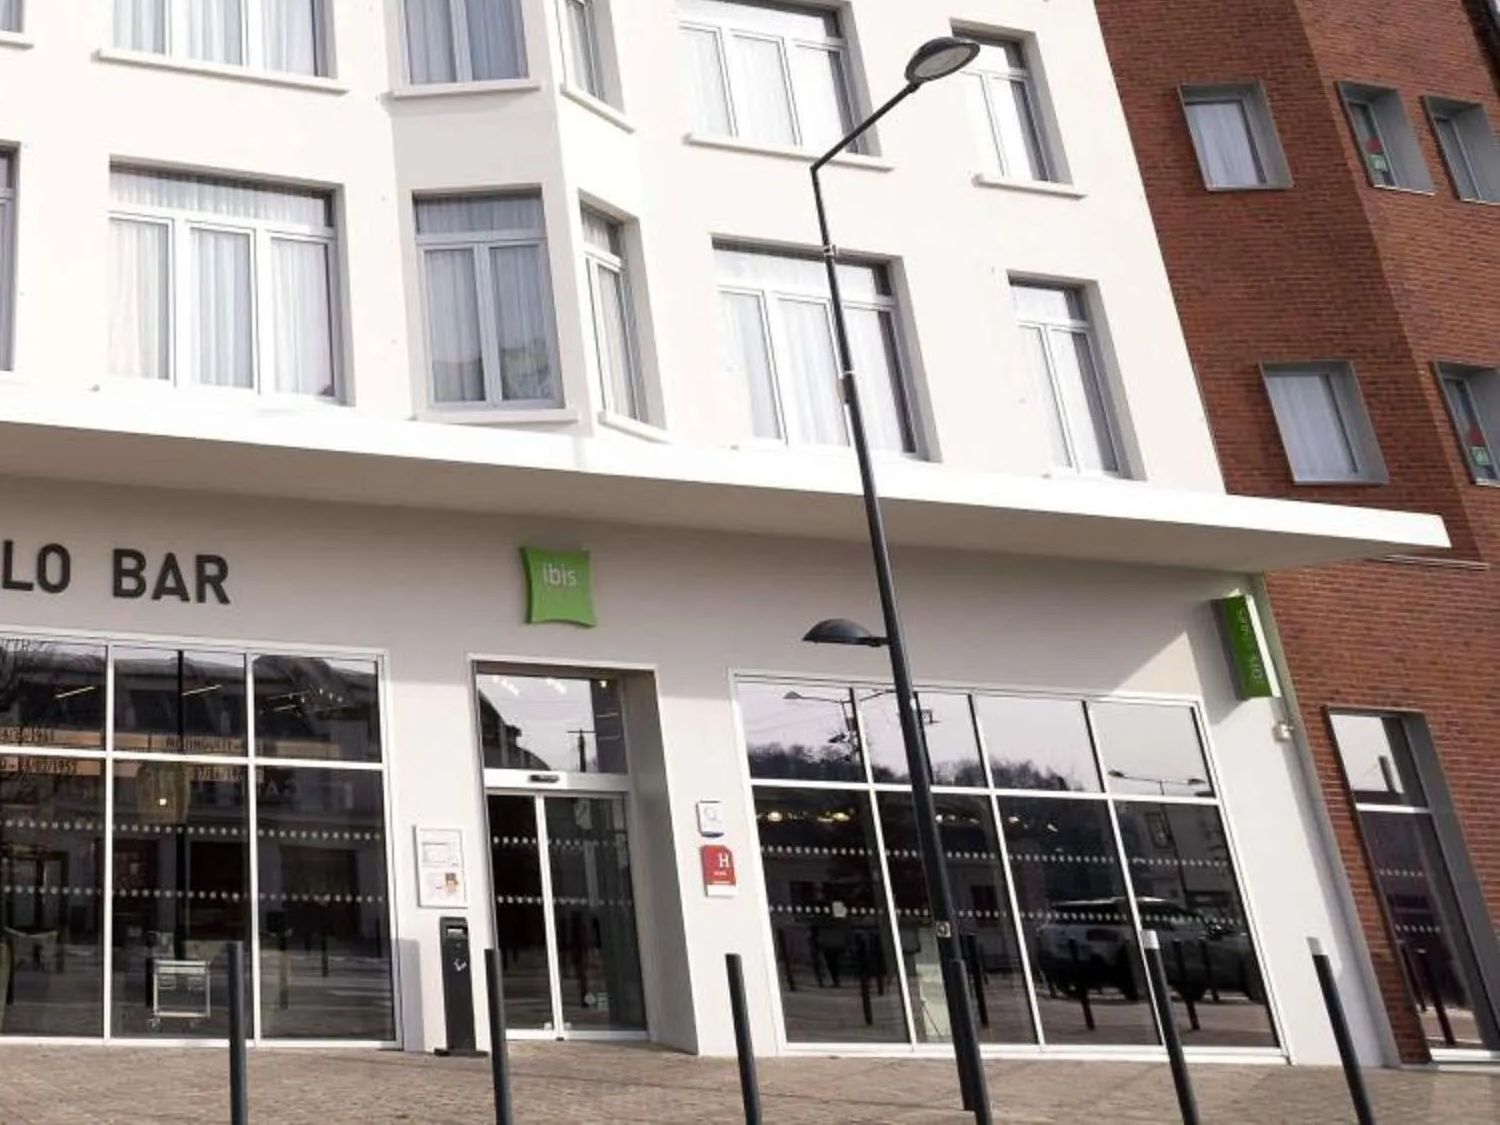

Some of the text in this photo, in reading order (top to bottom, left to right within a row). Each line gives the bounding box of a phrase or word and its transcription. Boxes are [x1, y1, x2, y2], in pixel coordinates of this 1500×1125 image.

[112, 547, 231, 605] BAR
[542, 562, 577, 588] ibis
[717, 852, 731, 869] H
